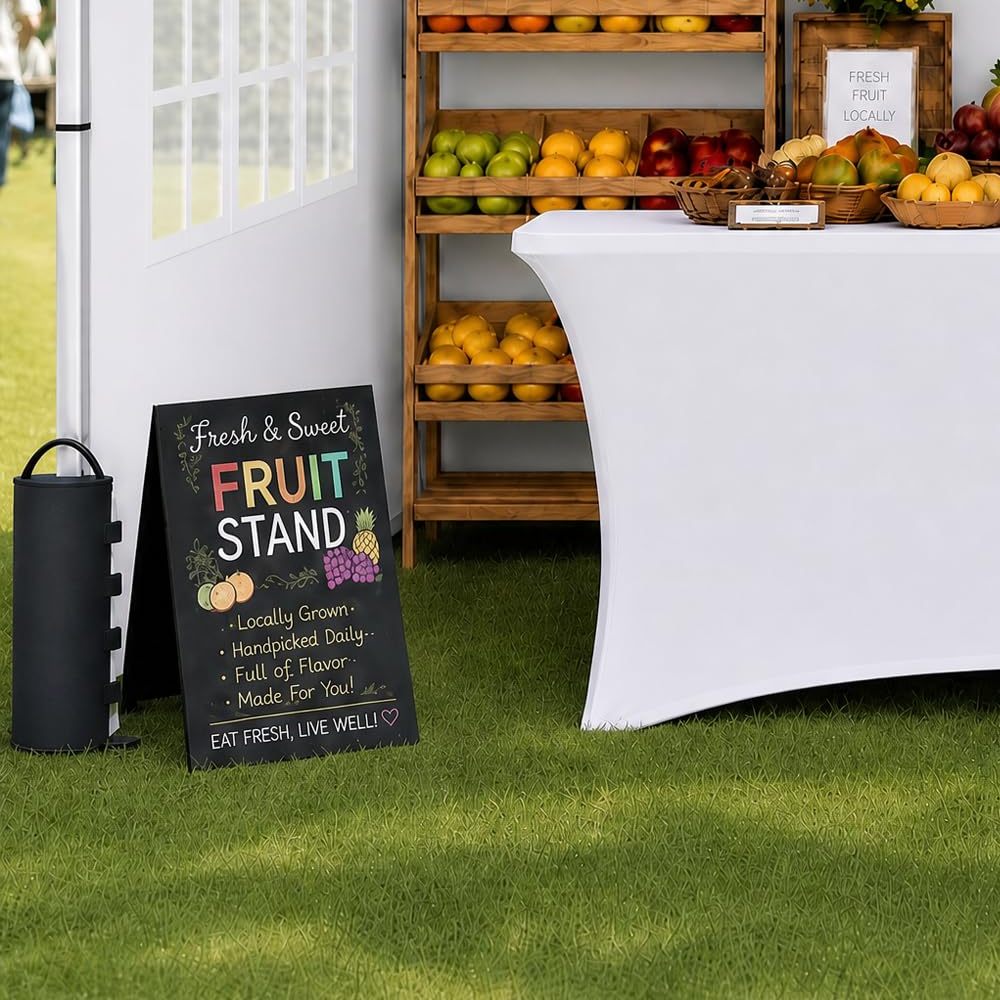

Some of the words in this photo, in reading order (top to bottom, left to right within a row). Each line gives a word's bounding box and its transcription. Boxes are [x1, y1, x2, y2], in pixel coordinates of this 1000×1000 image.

[849, 71, 889, 82] FRESH
[852, 90, 887, 101] FRUIT
[843, 110, 896, 121] LOCALLY
[190, 415, 257, 454] Fresh
[264, 417, 282, 441] &
[288, 409, 350, 441] Sweet
[211, 452, 349, 511] FRUIT
[218, 507, 346, 561] STAND
[237, 609, 293, 631] Locally
[298, 603, 349, 624] Grown
[232, 631, 319, 658] Handpicked
[326, 626, 364, 650] Daily
[235, 663, 265, 683] Full
[274, 659, 293, 680] of
[299, 656, 347, 674] Flavor
[238, 690, 283, 709] Made
[290, 688, 316, 703] For
[320, 676, 354, 697] You!
[211, 731, 238, 750] EAT
[244, 725, 294, 746] FRESH,
[298, 721, 329, 738] LIVE
[334, 712, 378, 732] WELL!
